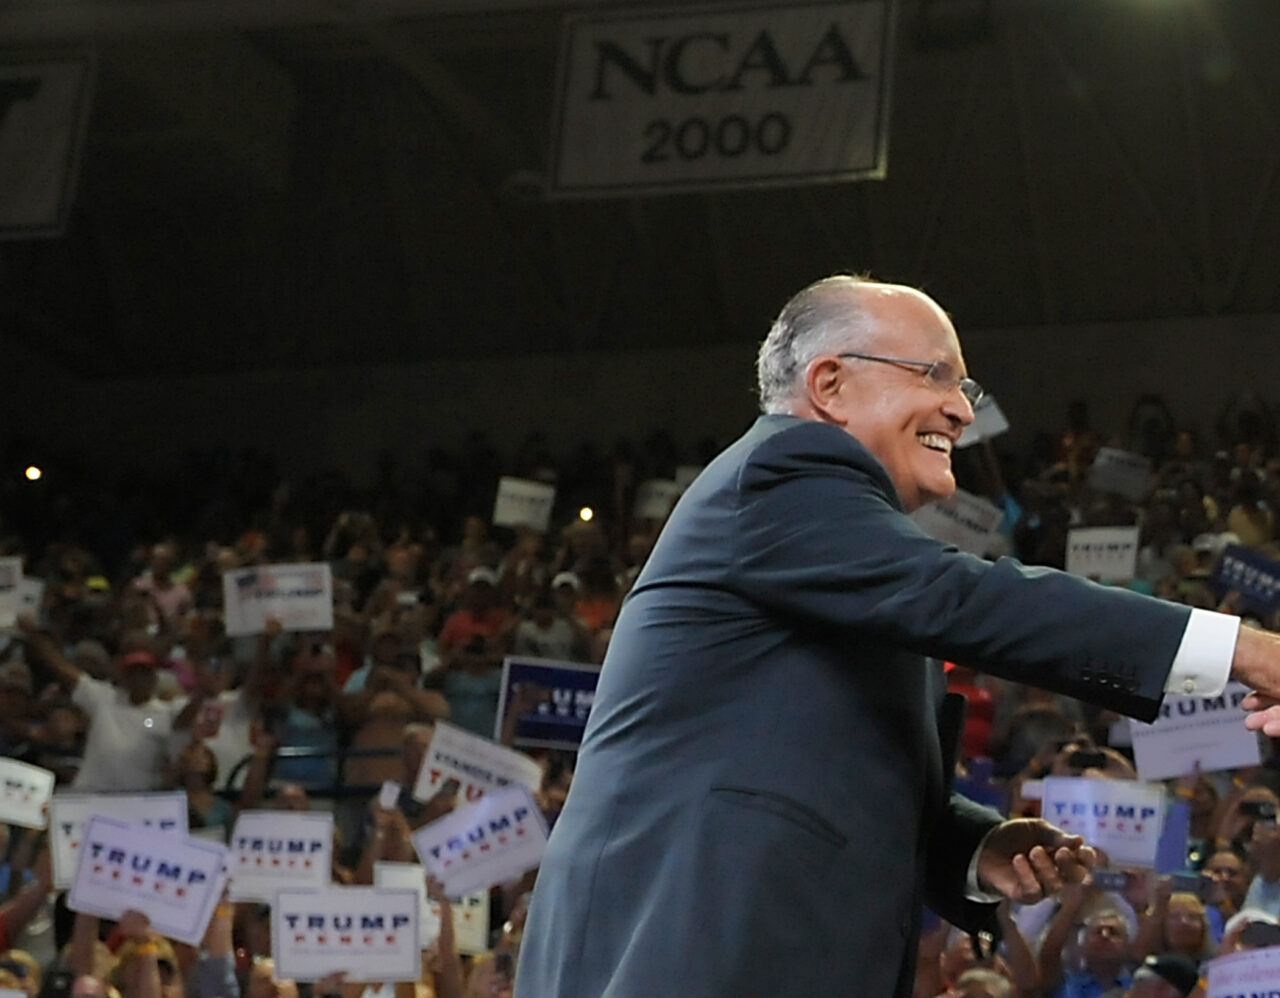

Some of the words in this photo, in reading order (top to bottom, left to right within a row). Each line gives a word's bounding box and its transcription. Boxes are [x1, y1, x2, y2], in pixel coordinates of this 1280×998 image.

[594, 21, 872, 101] NCAA
[640, 111, 793, 166] 2000
[1158, 693, 1247, 720] RUMP
[1053, 802, 1156, 820] TRUMP
[239, 838, 323, 854] TRUMP
[91, 843, 206, 885] TRUMP
[285, 914, 409, 931] TRUMP
